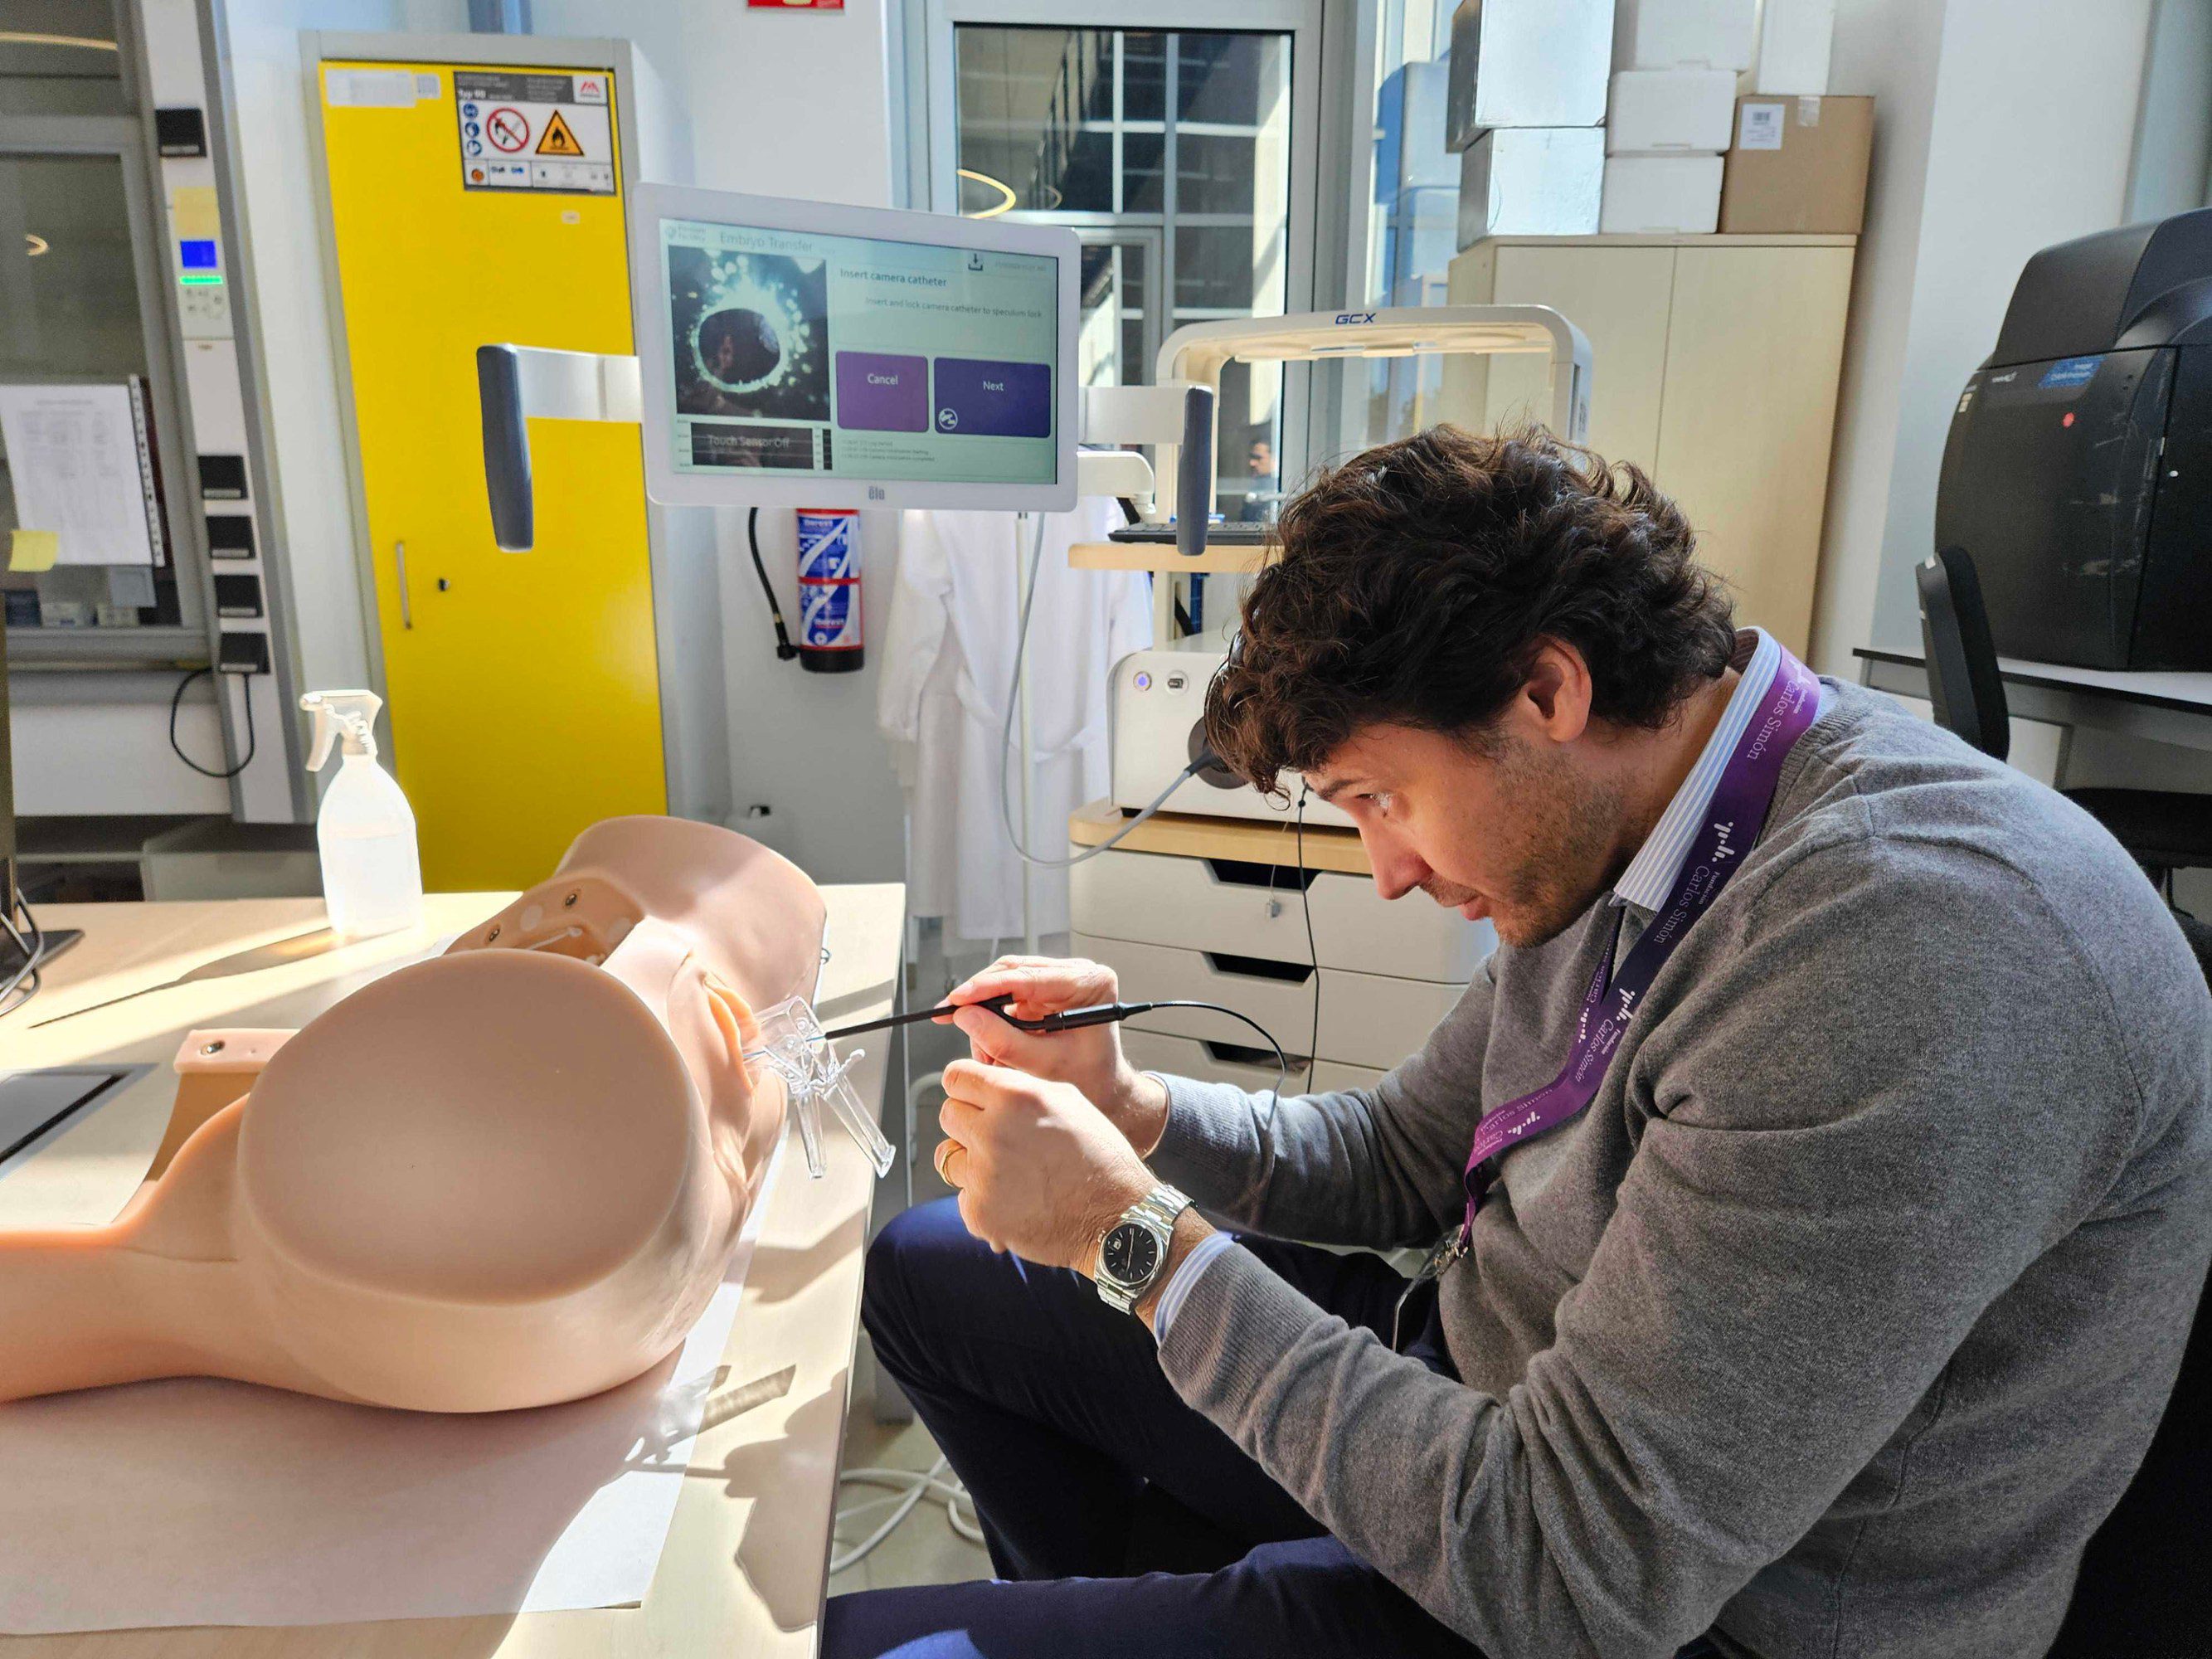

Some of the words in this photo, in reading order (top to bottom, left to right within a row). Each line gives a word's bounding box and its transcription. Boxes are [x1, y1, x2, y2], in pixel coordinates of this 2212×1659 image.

[720, 232, 764, 249] Embryo
[768, 236, 813, 252] Transfer
[840, 268, 868, 280] Insert
[871, 273, 906, 284] camera
[907, 275, 947, 288] catheter
[889, 299, 904, 308] and
[905, 299, 920, 309] lock
[922, 303, 950, 312] camera
[950, 304, 982, 314] catheter
[992, 308, 1027, 318] speculum
[1335, 313, 1377, 324] GCX
[868, 373, 898, 386] Cancel
[983, 381, 1004, 392] Next
[707, 435, 737, 446] Touch
[774, 437, 790, 448] Off
[1773, 680, 1800, 716] Carlos
[1747, 718, 1782, 760] Simón
[1680, 865, 1710, 907] Carlos
[1653, 908, 1687, 944] Simón
[1590, 1019, 1614, 1052] Carlos
[1575, 1049, 1594, 1082] Simón
